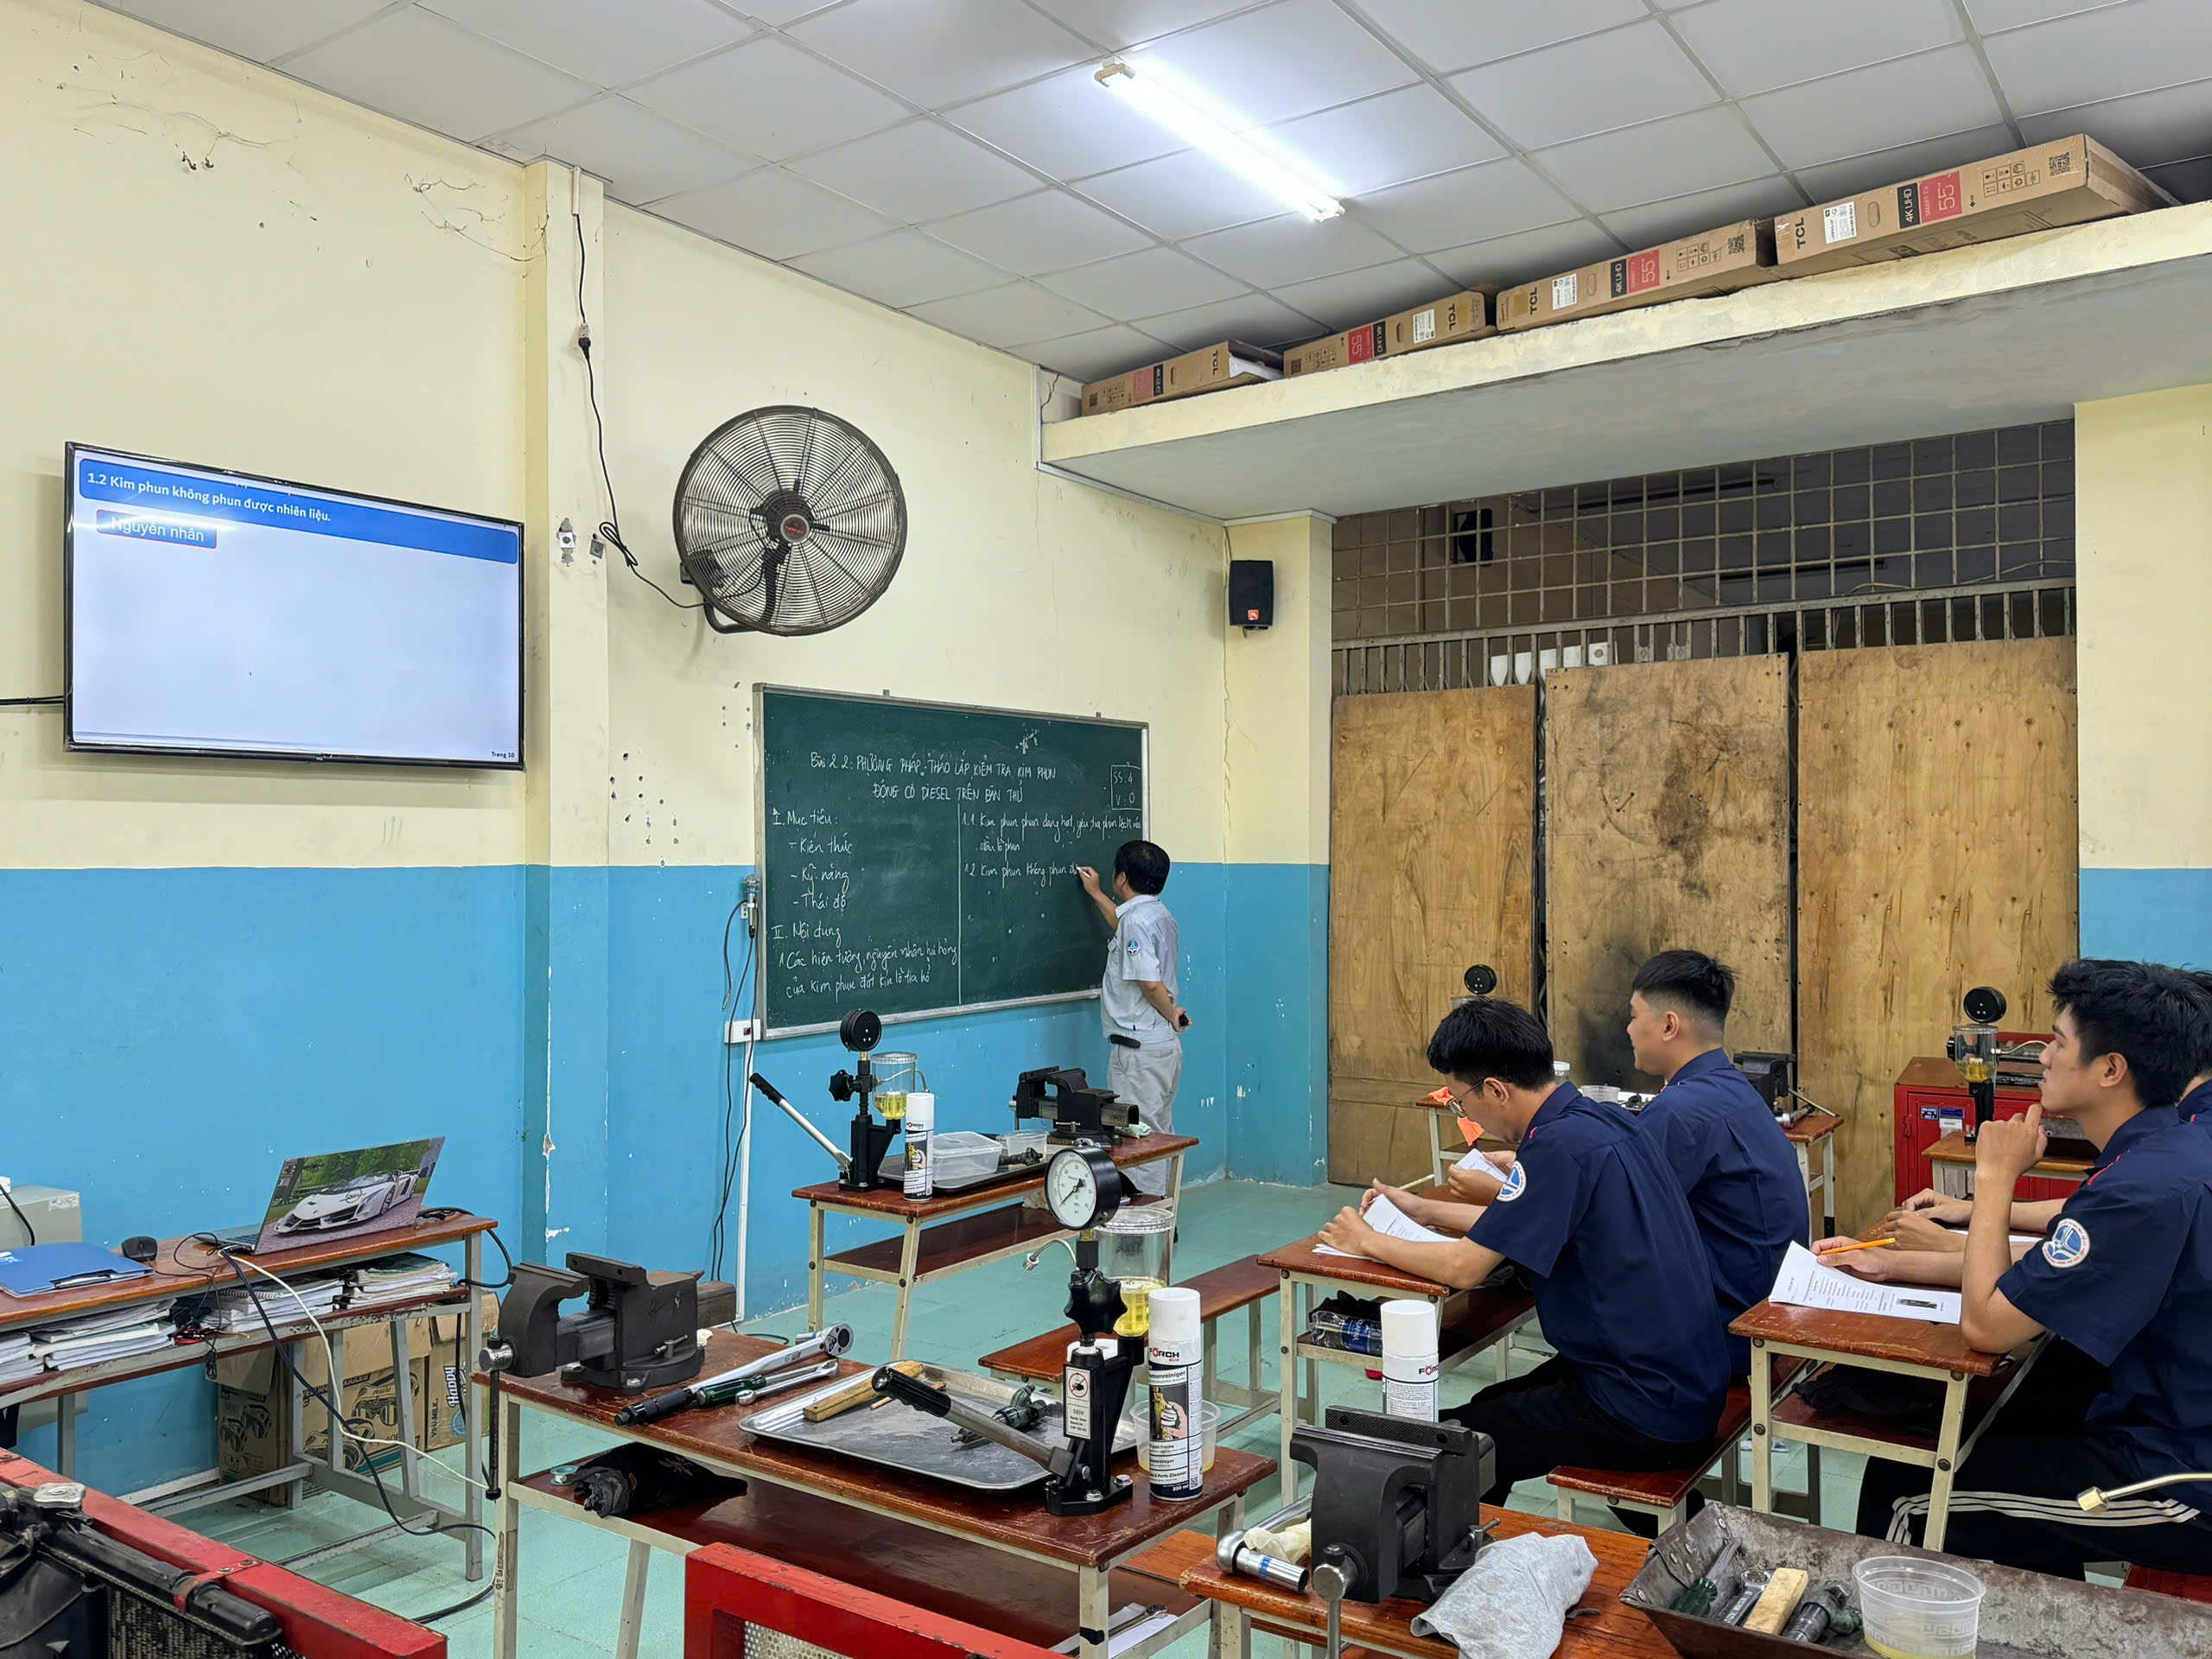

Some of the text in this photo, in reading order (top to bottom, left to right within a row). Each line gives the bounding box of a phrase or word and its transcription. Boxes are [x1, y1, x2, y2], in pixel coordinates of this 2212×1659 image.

[1796, 217, 1806, 250] TCL
[1529, 286, 1538, 315] TCL
[1447, 303, 1458, 332] TCL
[87, 473, 331, 522] 1.2 Kim phun không phun được nhiên liệu.
[111, 516, 204, 542] Nguyên nhân
[921, 785, 950, 800] DIESEL
[956, 783, 980, 801] TRÊN
[813, 920, 842, 949] dung
